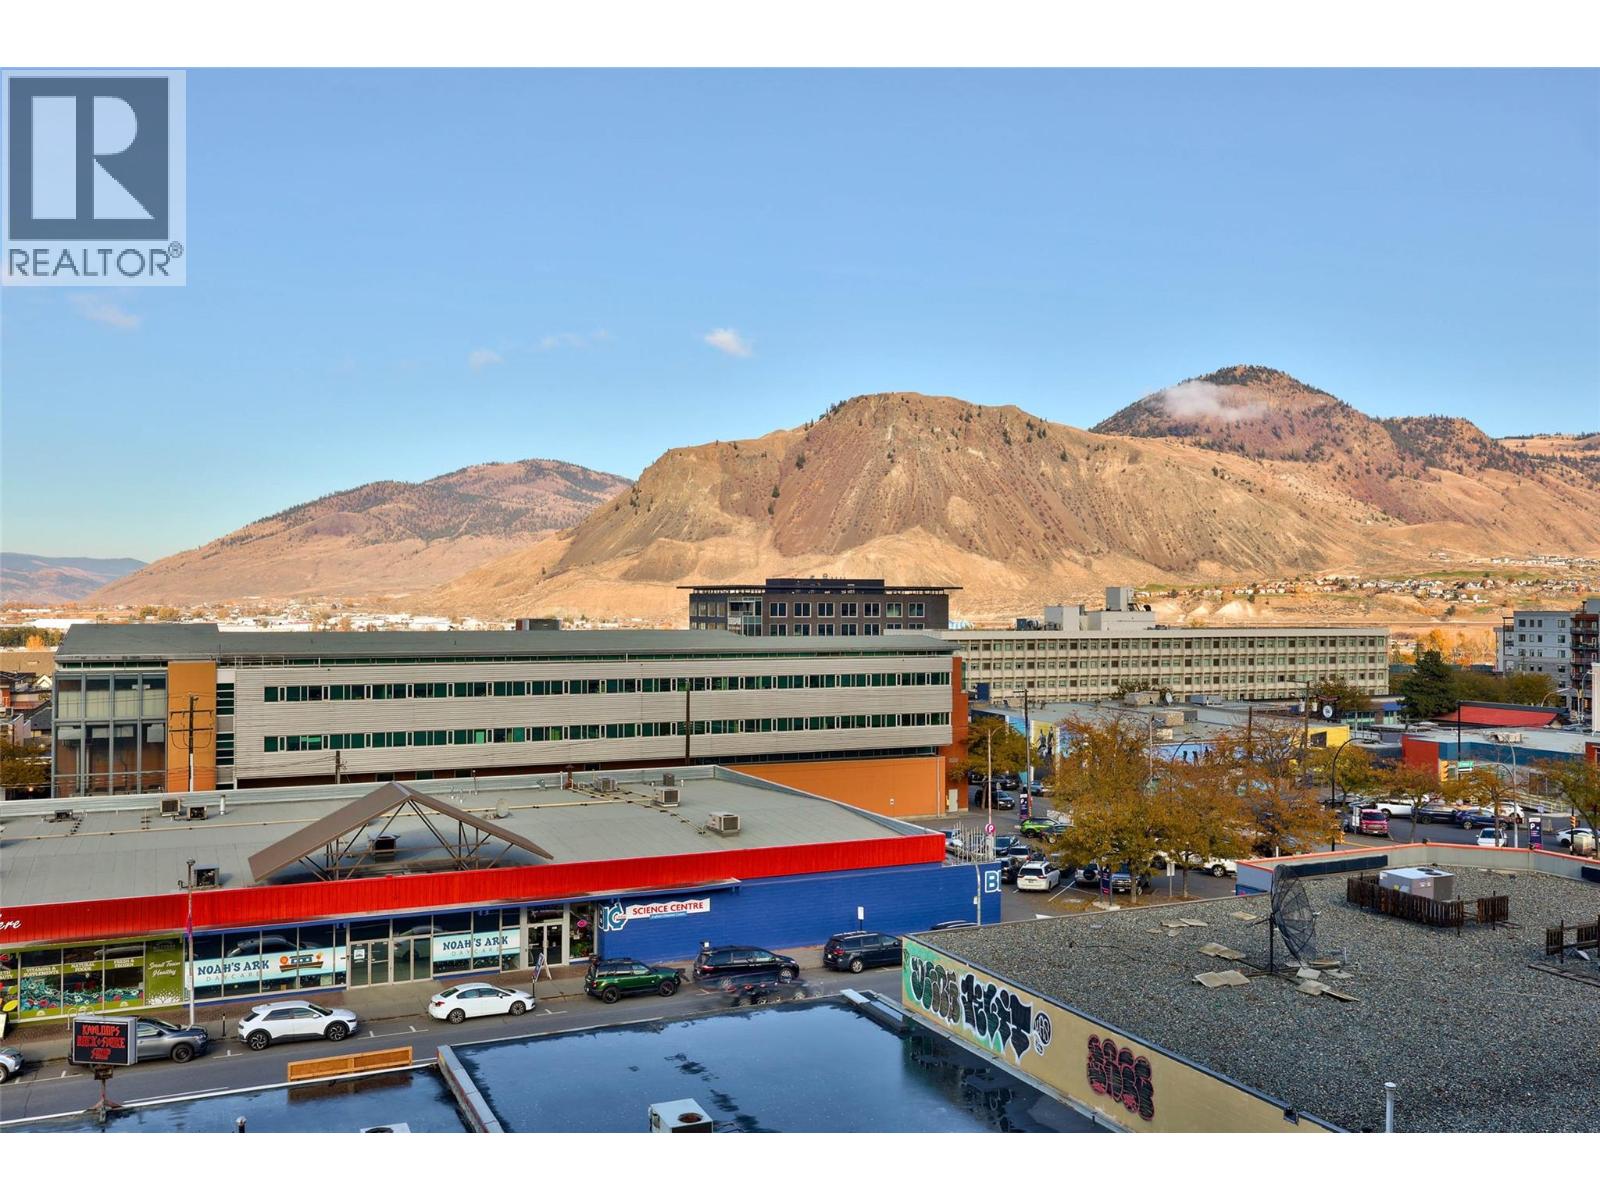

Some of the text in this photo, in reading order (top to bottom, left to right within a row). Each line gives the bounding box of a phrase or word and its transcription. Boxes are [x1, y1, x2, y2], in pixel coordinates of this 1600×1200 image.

[632, 902, 704, 915] SCIENCE CENTRE
[442, 936, 509, 951] NOAH'S ARK
[197, 959, 270, 976] NOAH'S ARK
